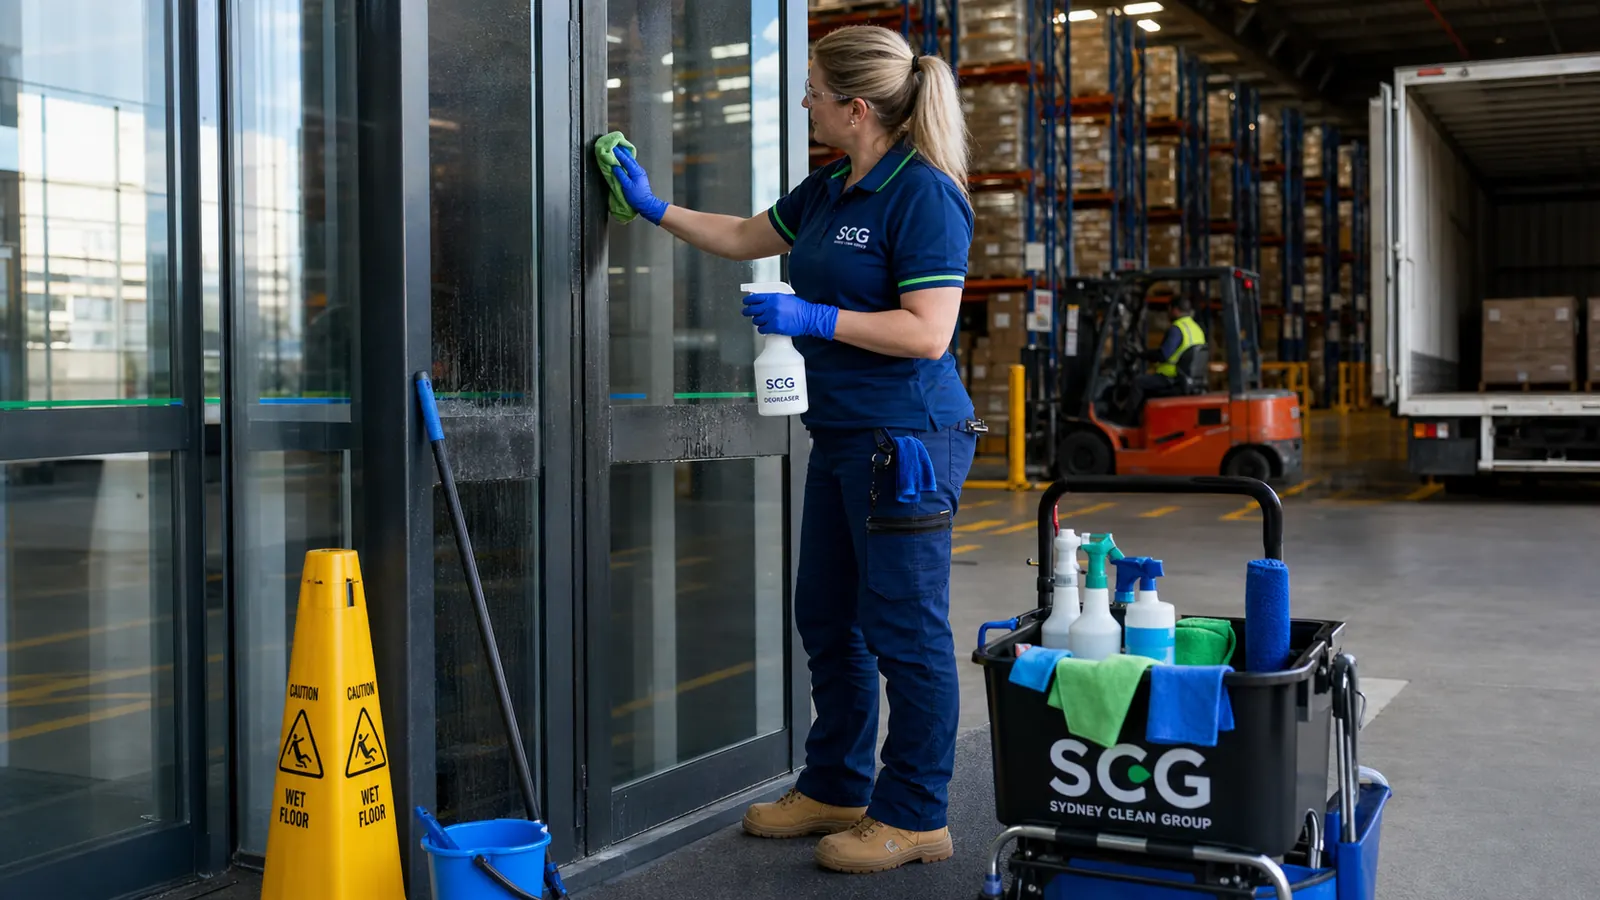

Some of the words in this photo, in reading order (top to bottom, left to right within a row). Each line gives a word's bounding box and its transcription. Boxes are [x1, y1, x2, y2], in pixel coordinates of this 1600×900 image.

[836, 225, 870, 244] SCG
[766, 377, 795, 390] SCG
[289, 683, 319, 701] CAUTION
[347, 681, 375, 701] CAUTION
[1049, 738, 1211, 810] SCG
[285, 787, 306, 808] WET
[360, 785, 380, 806] WET
[279, 806, 309, 829] FLOOR
[359, 803, 386, 828] FLOOR
[1049, 800, 1104, 818] SYDNEY
[1108, 807, 1156, 824] CLEAN
[1161, 813, 1212, 830] GROUP
